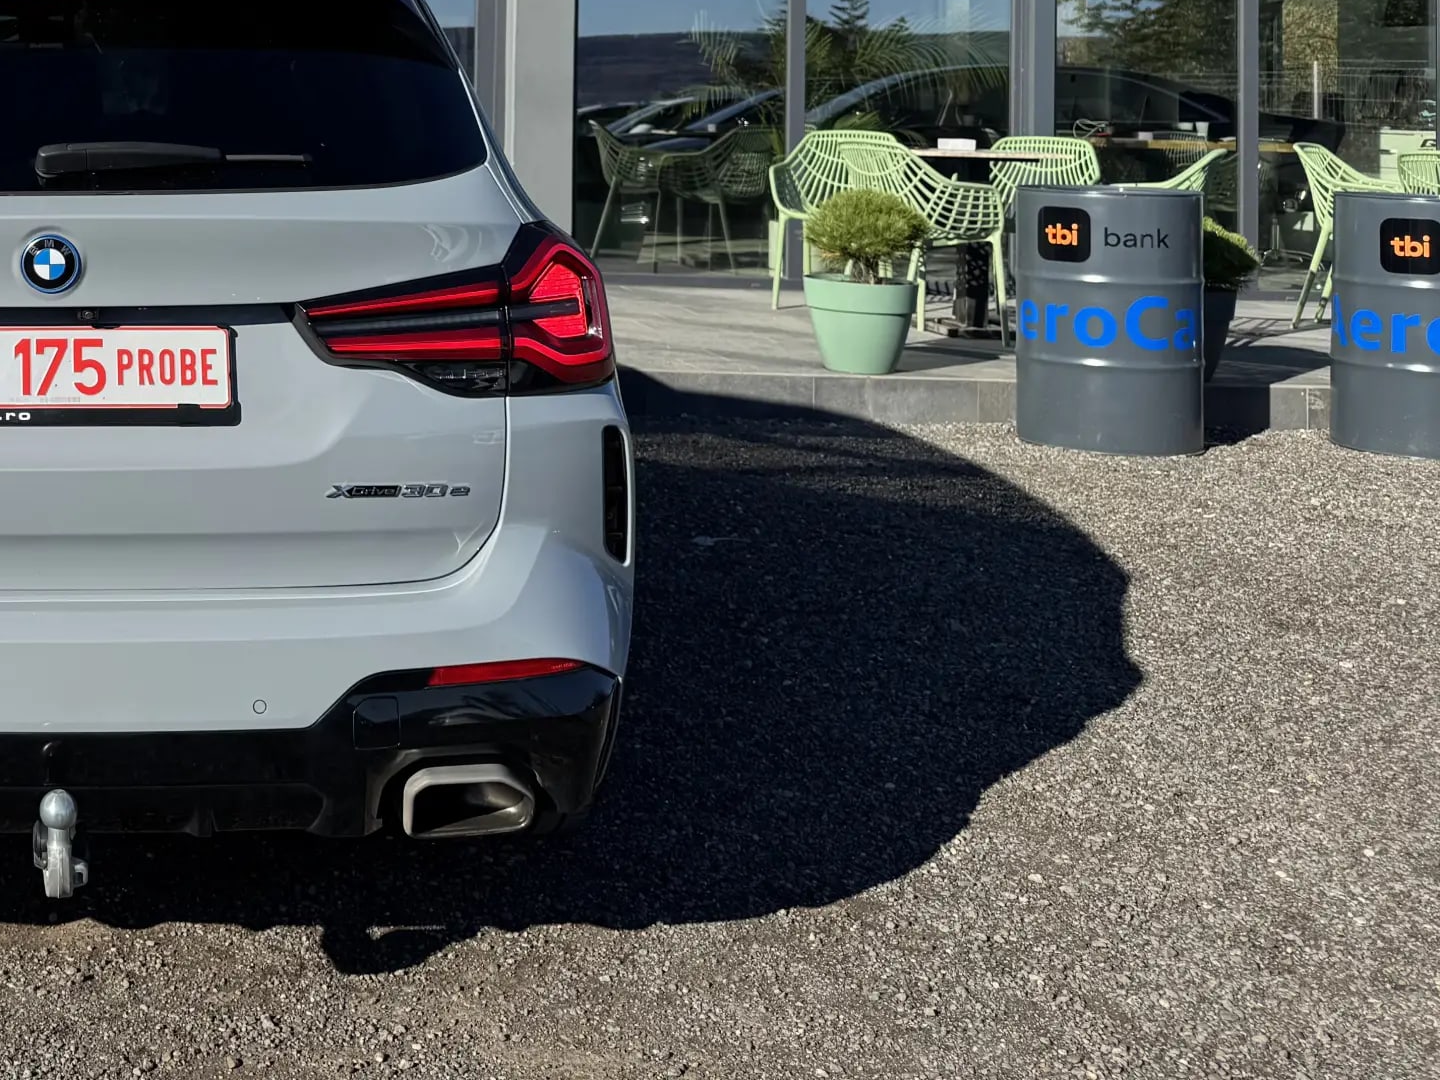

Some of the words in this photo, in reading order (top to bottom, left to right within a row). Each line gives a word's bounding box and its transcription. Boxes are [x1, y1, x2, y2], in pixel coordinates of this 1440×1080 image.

[1045, 223, 1079, 246] tbi
[1104, 227, 1169, 249] bank
[1390, 235, 1431, 258] tbi
[14, 338, 107, 397] 175
[117, 348, 219, 386] PROBE
